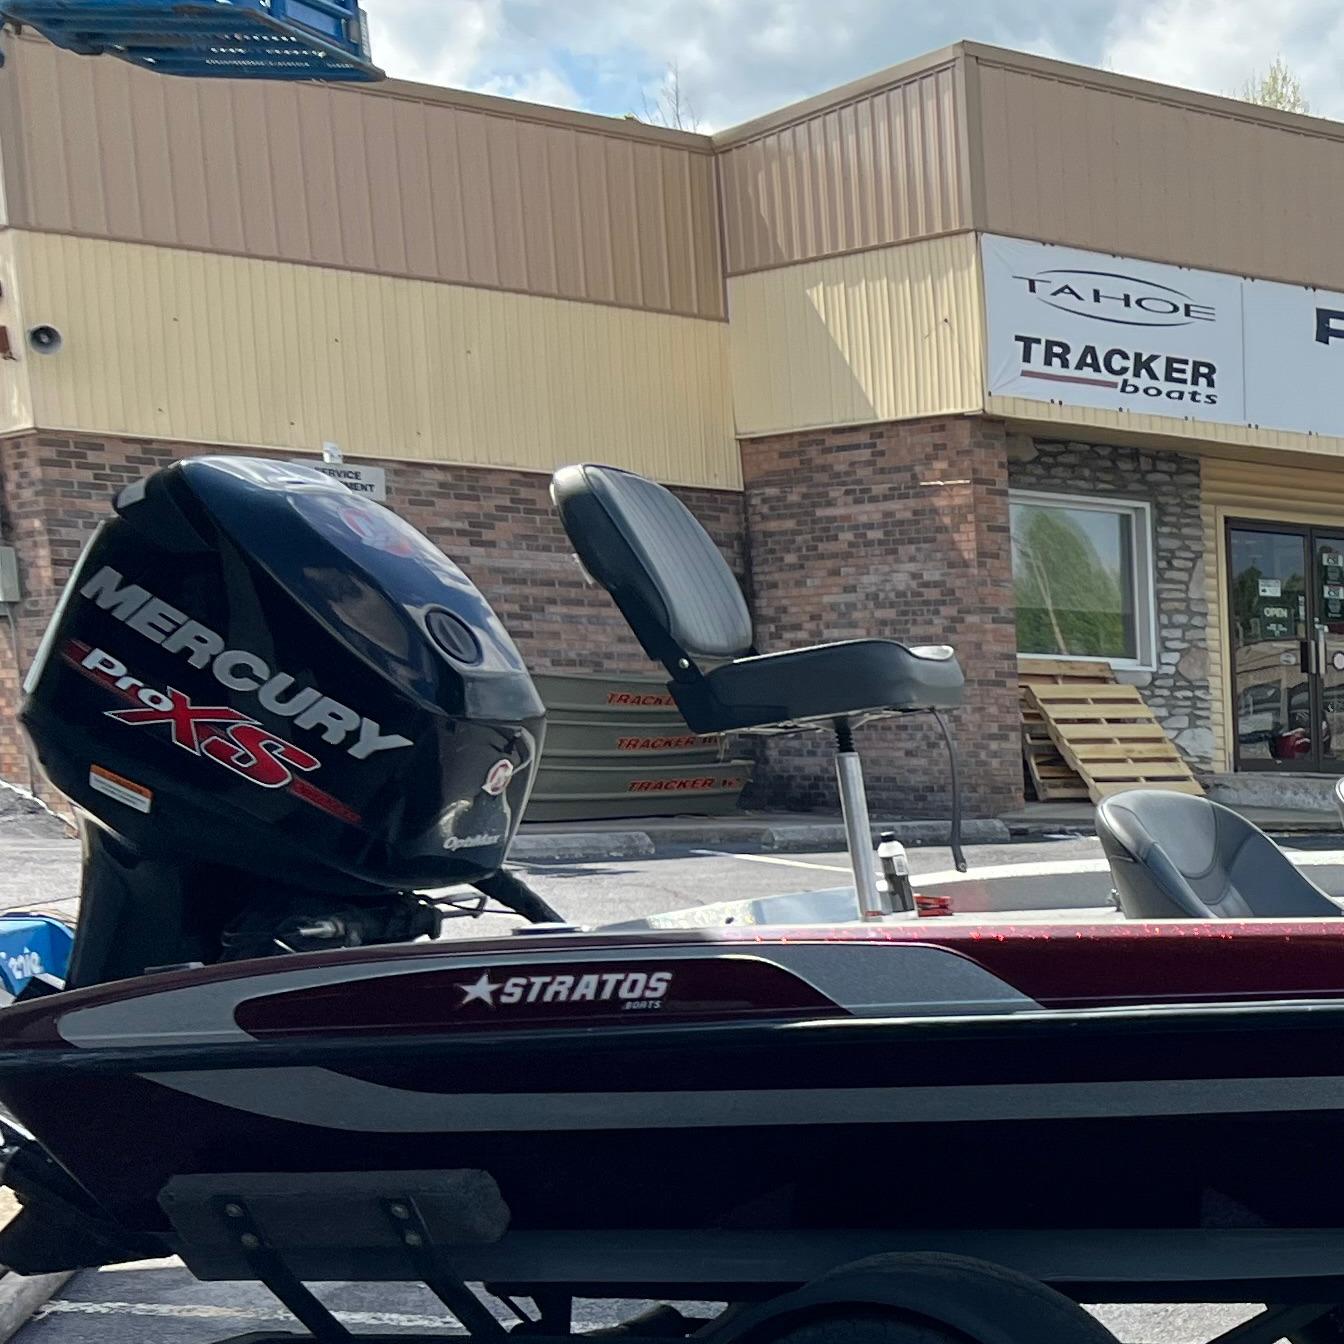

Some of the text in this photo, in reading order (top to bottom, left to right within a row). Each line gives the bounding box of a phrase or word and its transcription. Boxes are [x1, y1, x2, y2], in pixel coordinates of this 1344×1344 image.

[1011, 274, 1216, 323] TAHOE
[1014, 334, 1218, 388] TRACKER
[1119, 378, 1218, 405] boats
[315, 467, 361, 480] ERVICE
[340, 481, 375, 493] MENT
[1263, 607, 1288, 618] OPEN
[79, 565, 414, 760] MERCURY
[81, 647, 322, 788] Pro XS
[628, 778, 715, 792] TRACKER
[500, 972, 673, 1004] STRATOS
